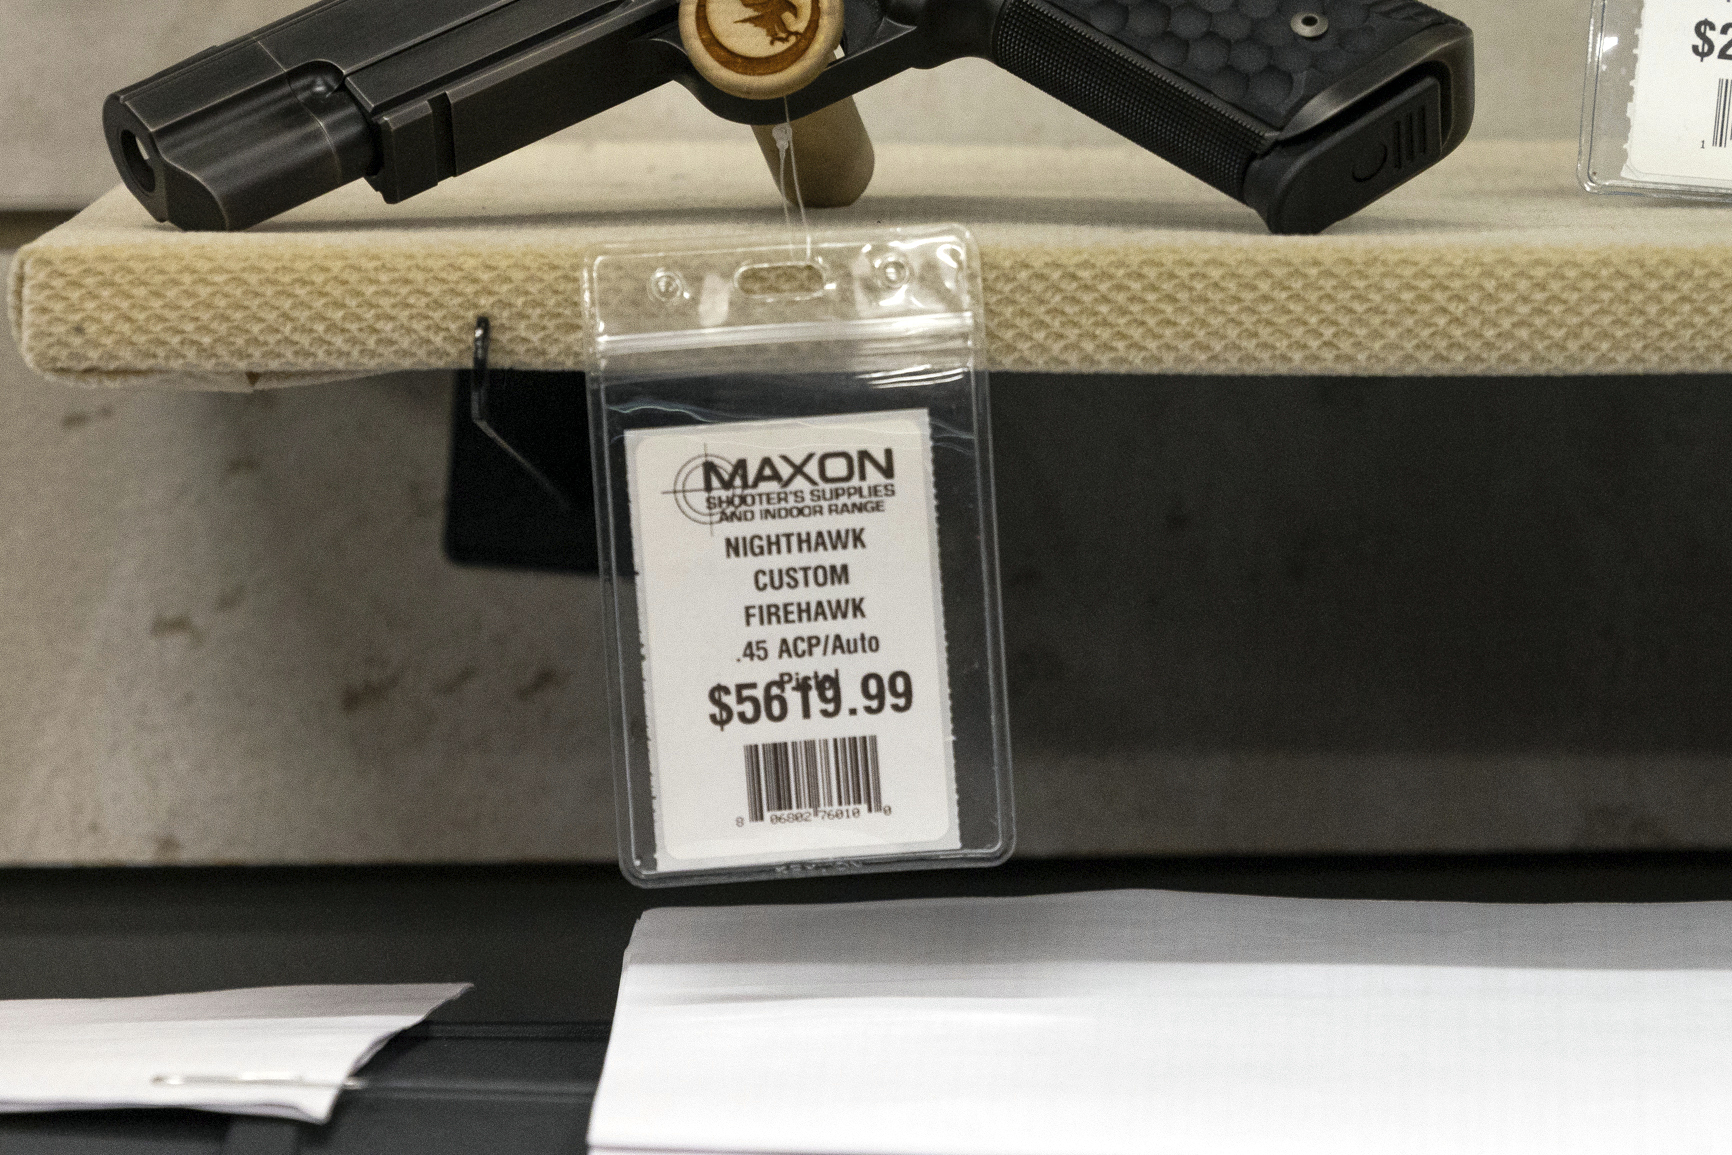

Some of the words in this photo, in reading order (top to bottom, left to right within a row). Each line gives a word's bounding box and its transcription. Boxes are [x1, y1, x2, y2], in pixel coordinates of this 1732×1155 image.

[702, 447, 895, 493] MAXON
[705, 490, 805, 511] SHOOTER'S
[809, 483, 896, 503] SUPPLIES
[718, 508, 755, 523] AND
[760, 504, 824, 521] INDOOR
[827, 499, 885, 516] RANGE
[725, 527, 866, 558] NIGHTHAWK
[753, 563, 850, 592] CUSTOM
[744, 597, 866, 627] FIREHAWK
[736, 640, 769, 663] .45
[778, 632, 880, 660] ACP/Auto
[708, 669, 913, 732] $5619.99
